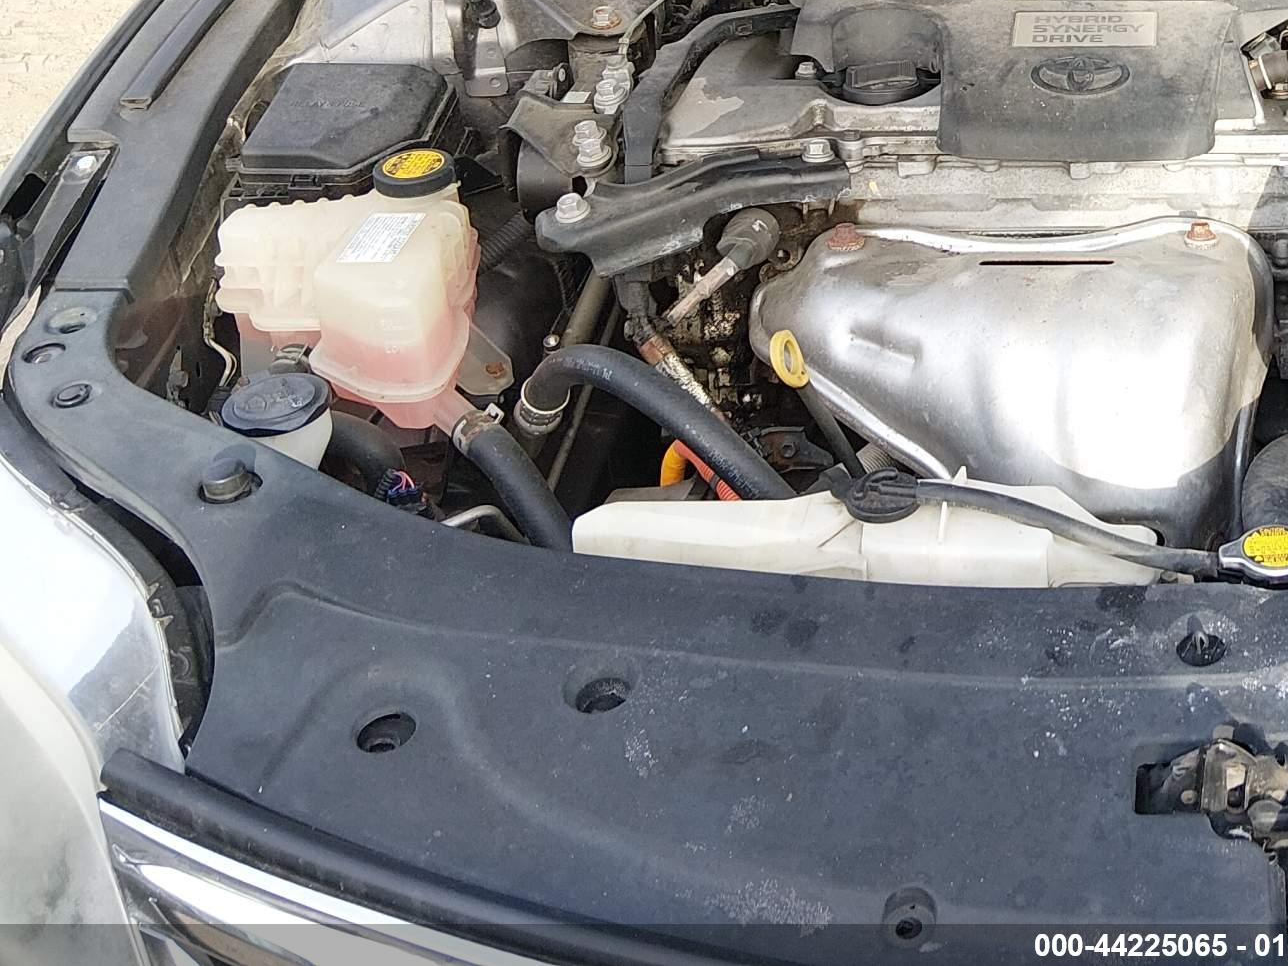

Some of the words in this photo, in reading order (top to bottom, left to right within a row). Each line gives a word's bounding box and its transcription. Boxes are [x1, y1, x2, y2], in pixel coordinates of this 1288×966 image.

[1034, 15, 1123, 24] HYBRID
[1032, 24, 1144, 33] SYNERGY
[1031, 34, 1104, 43] DRIVE
